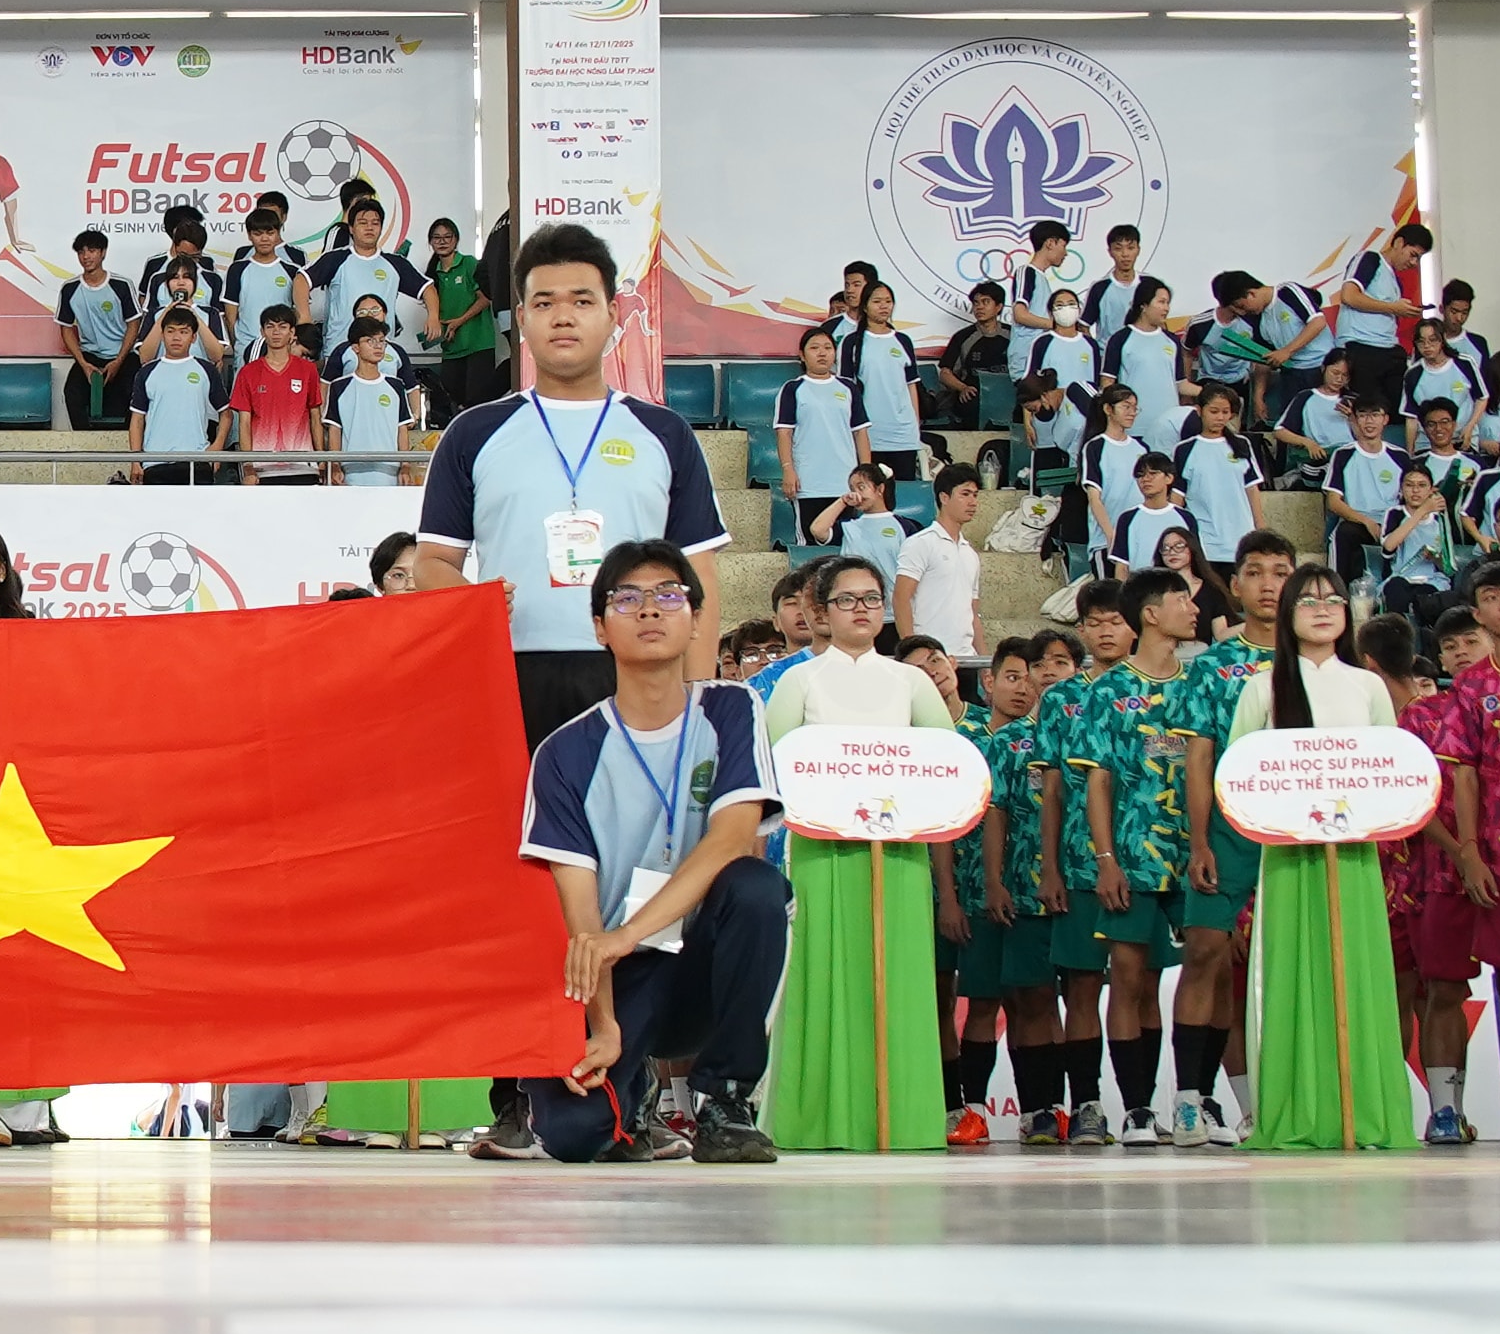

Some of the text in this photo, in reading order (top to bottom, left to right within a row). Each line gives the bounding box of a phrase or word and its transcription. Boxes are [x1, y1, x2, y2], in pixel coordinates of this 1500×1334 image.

[590, 40, 633, 48] 12/11/2025
[90, 46, 156, 67] VOV
[302, 46, 396, 64] HDBank
[884, 42, 1151, 142] HỘI THỂ THAO ĐẠI HỌC VÀ CHUYÊN NGHIỆP
[87, 142, 267, 183] Futsal
[86, 188, 209, 214] HDBank
[535, 198, 623, 216] HDBank
[87, 222, 145, 233] GIẢI SINH
[842, 740, 911, 757] TRƯỜNG
[1293, 736, 1358, 752] TRƯỜNG
[794, 760, 959, 778] ĐẠI HỌC MỞ TP.HCM
[1260, 756, 1395, 776] ĐẠI HỌC SƯ PHẠM
[1227, 773, 1428, 795] THỂ DỤC THỂ THAO TP.HCM
